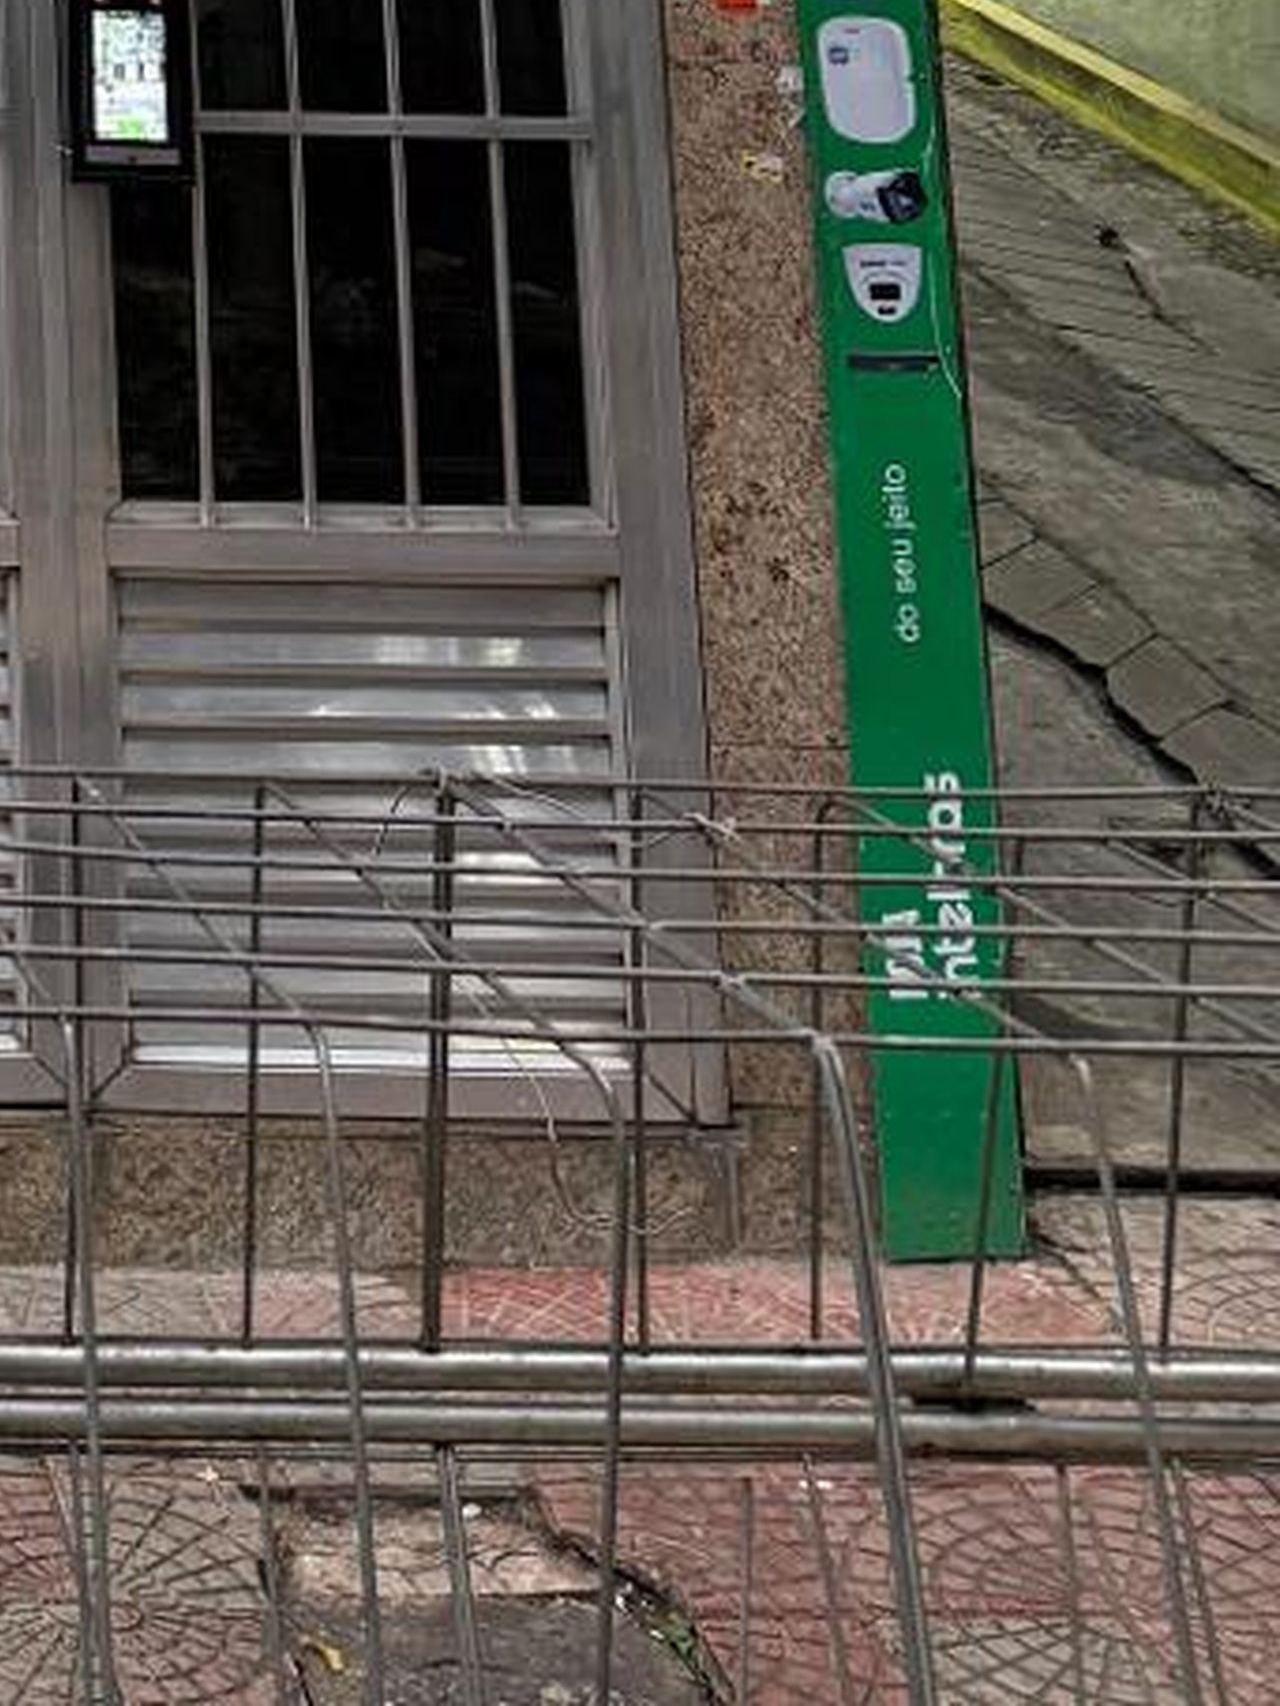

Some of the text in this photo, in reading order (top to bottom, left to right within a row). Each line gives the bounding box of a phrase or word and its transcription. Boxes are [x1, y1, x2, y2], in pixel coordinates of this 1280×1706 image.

[882, 463, 920, 643] do seu jeito
